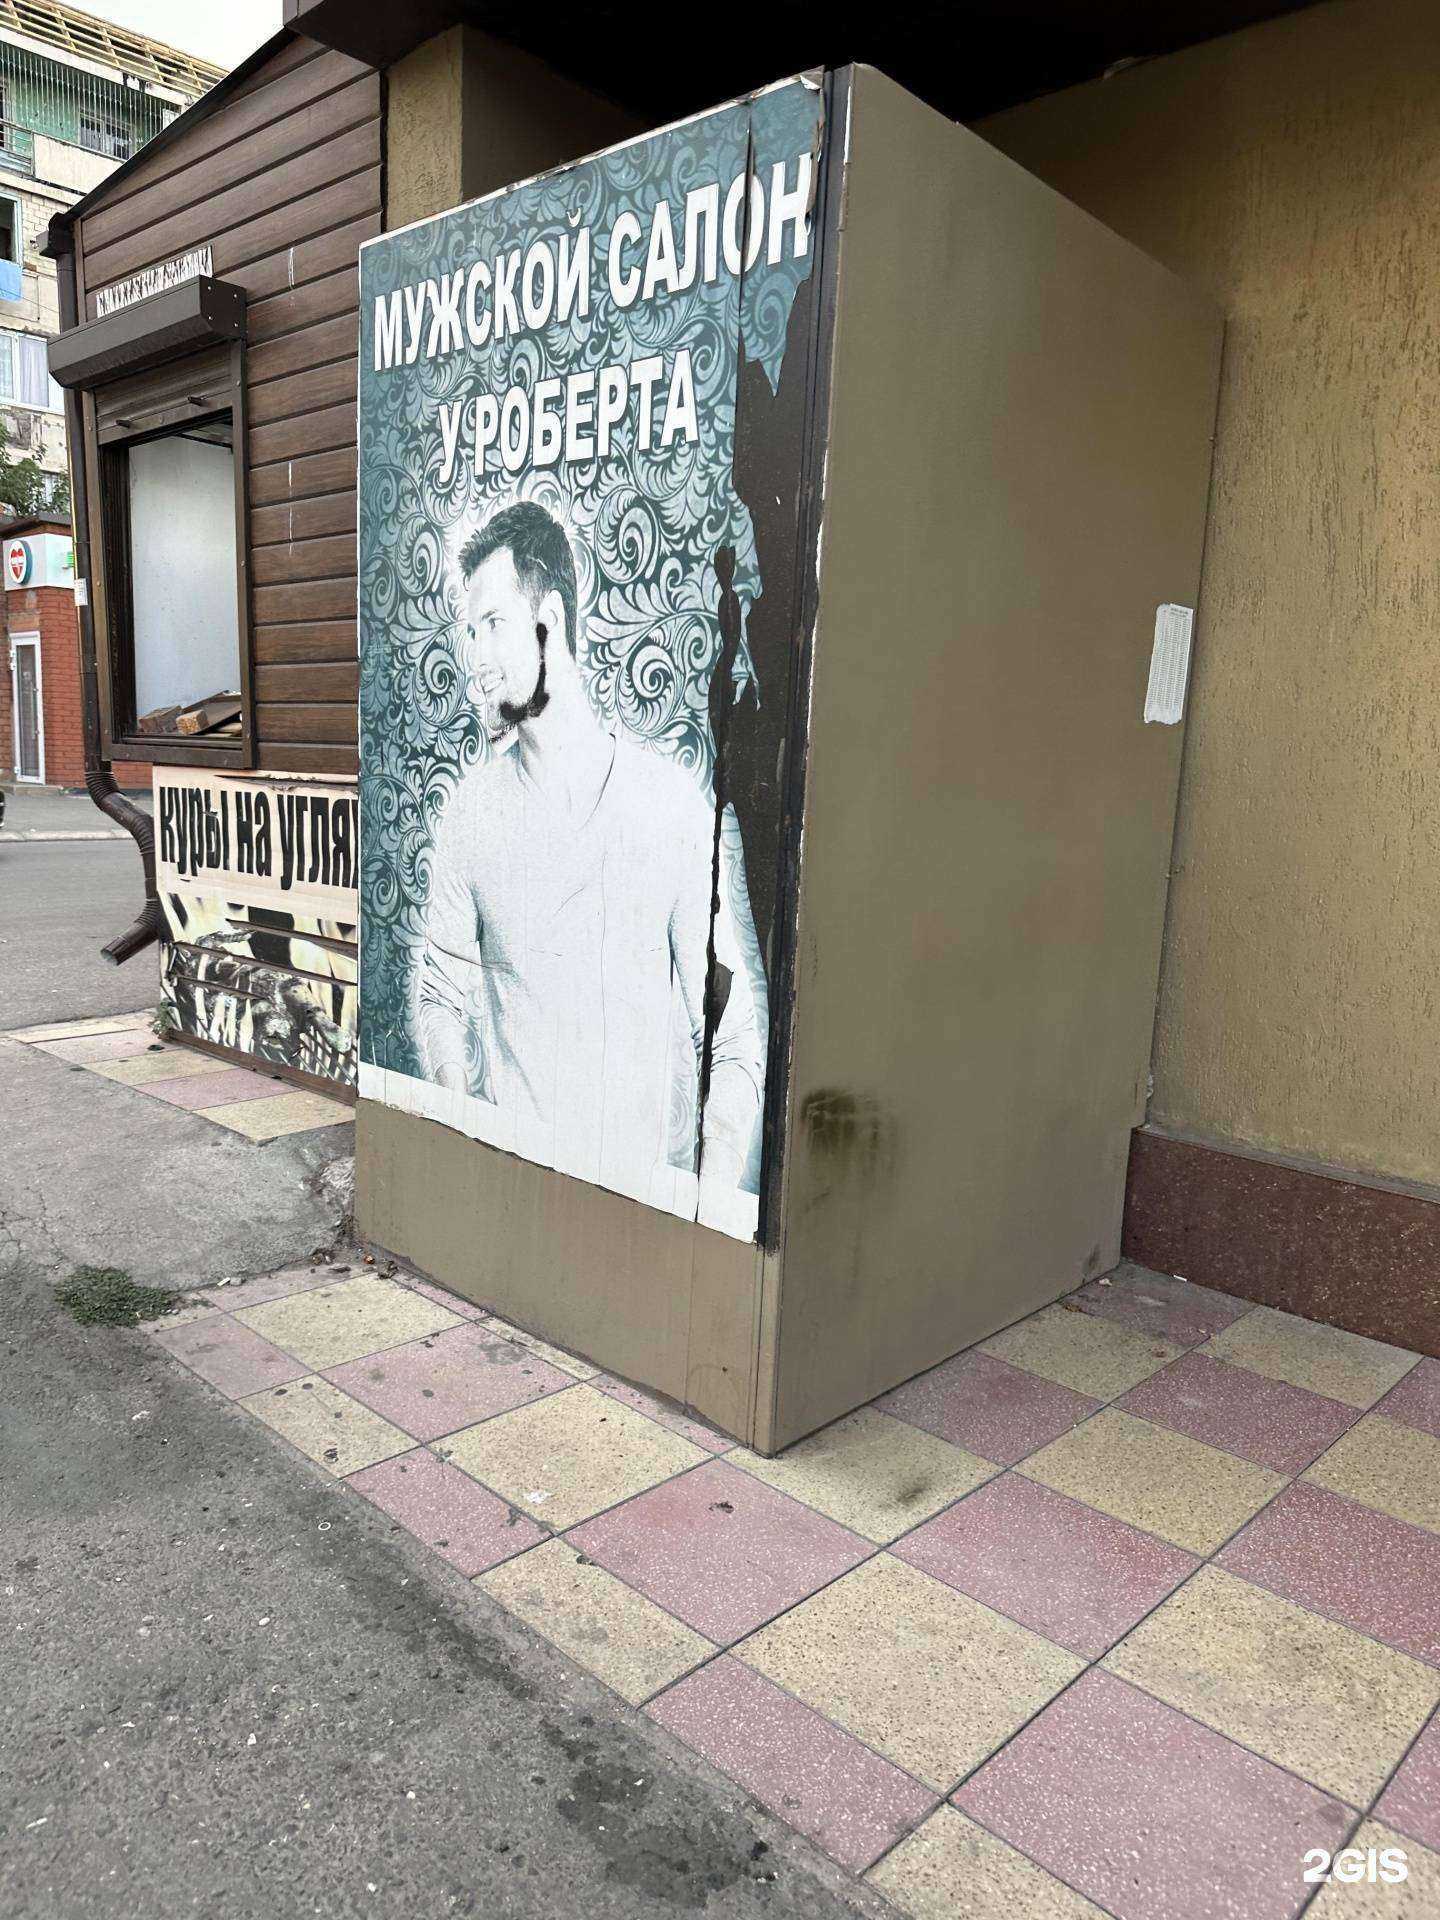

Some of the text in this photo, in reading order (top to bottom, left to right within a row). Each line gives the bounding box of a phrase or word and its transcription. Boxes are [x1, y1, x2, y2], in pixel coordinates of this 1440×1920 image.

[374, 207, 590, 372] МУЖСКОЙ
[607, 152, 813, 308] САЛОН
[438, 349, 699, 484] У РОБЕРТА
[159, 786, 231, 877] куры
[235, 791, 272, 877] на
